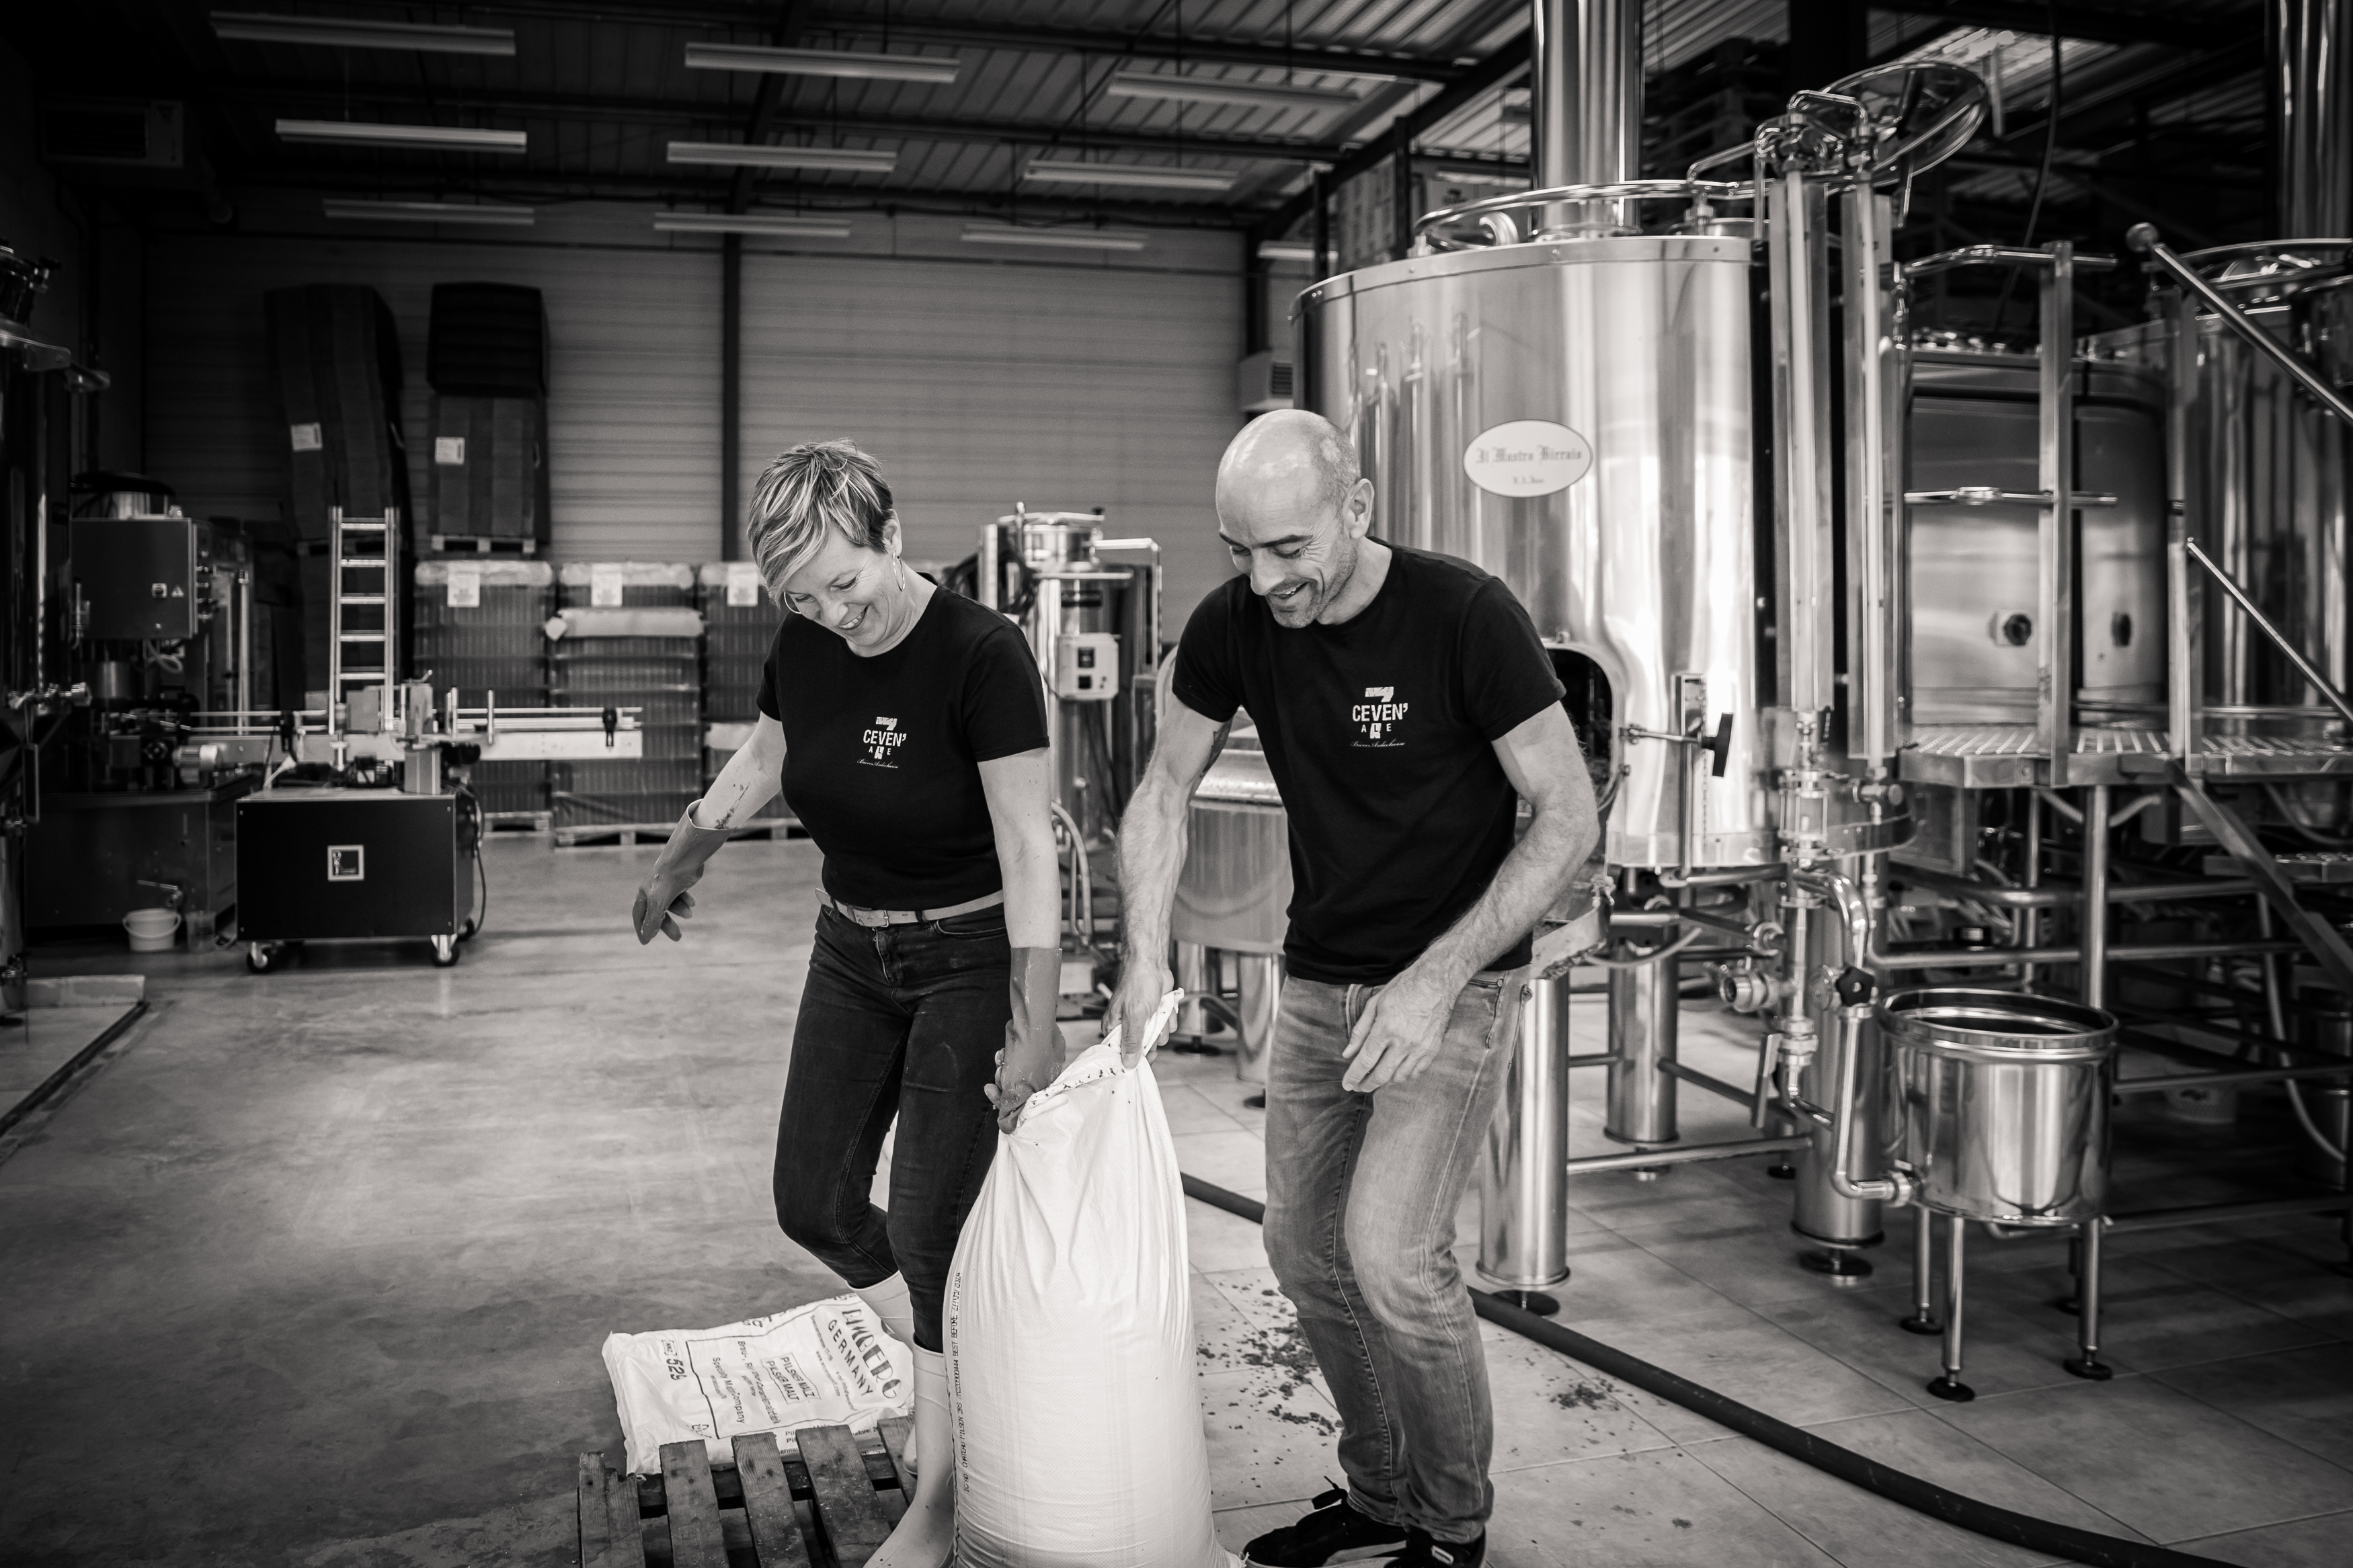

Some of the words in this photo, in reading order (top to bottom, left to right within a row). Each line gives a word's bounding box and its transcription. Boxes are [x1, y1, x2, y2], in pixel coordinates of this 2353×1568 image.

[1365, 686, 1394, 703] 7
[875, 716, 898, 731] 7
[950, 1315, 958, 1338] BEFORE
[828, 1319, 873, 1396] GERMANY
